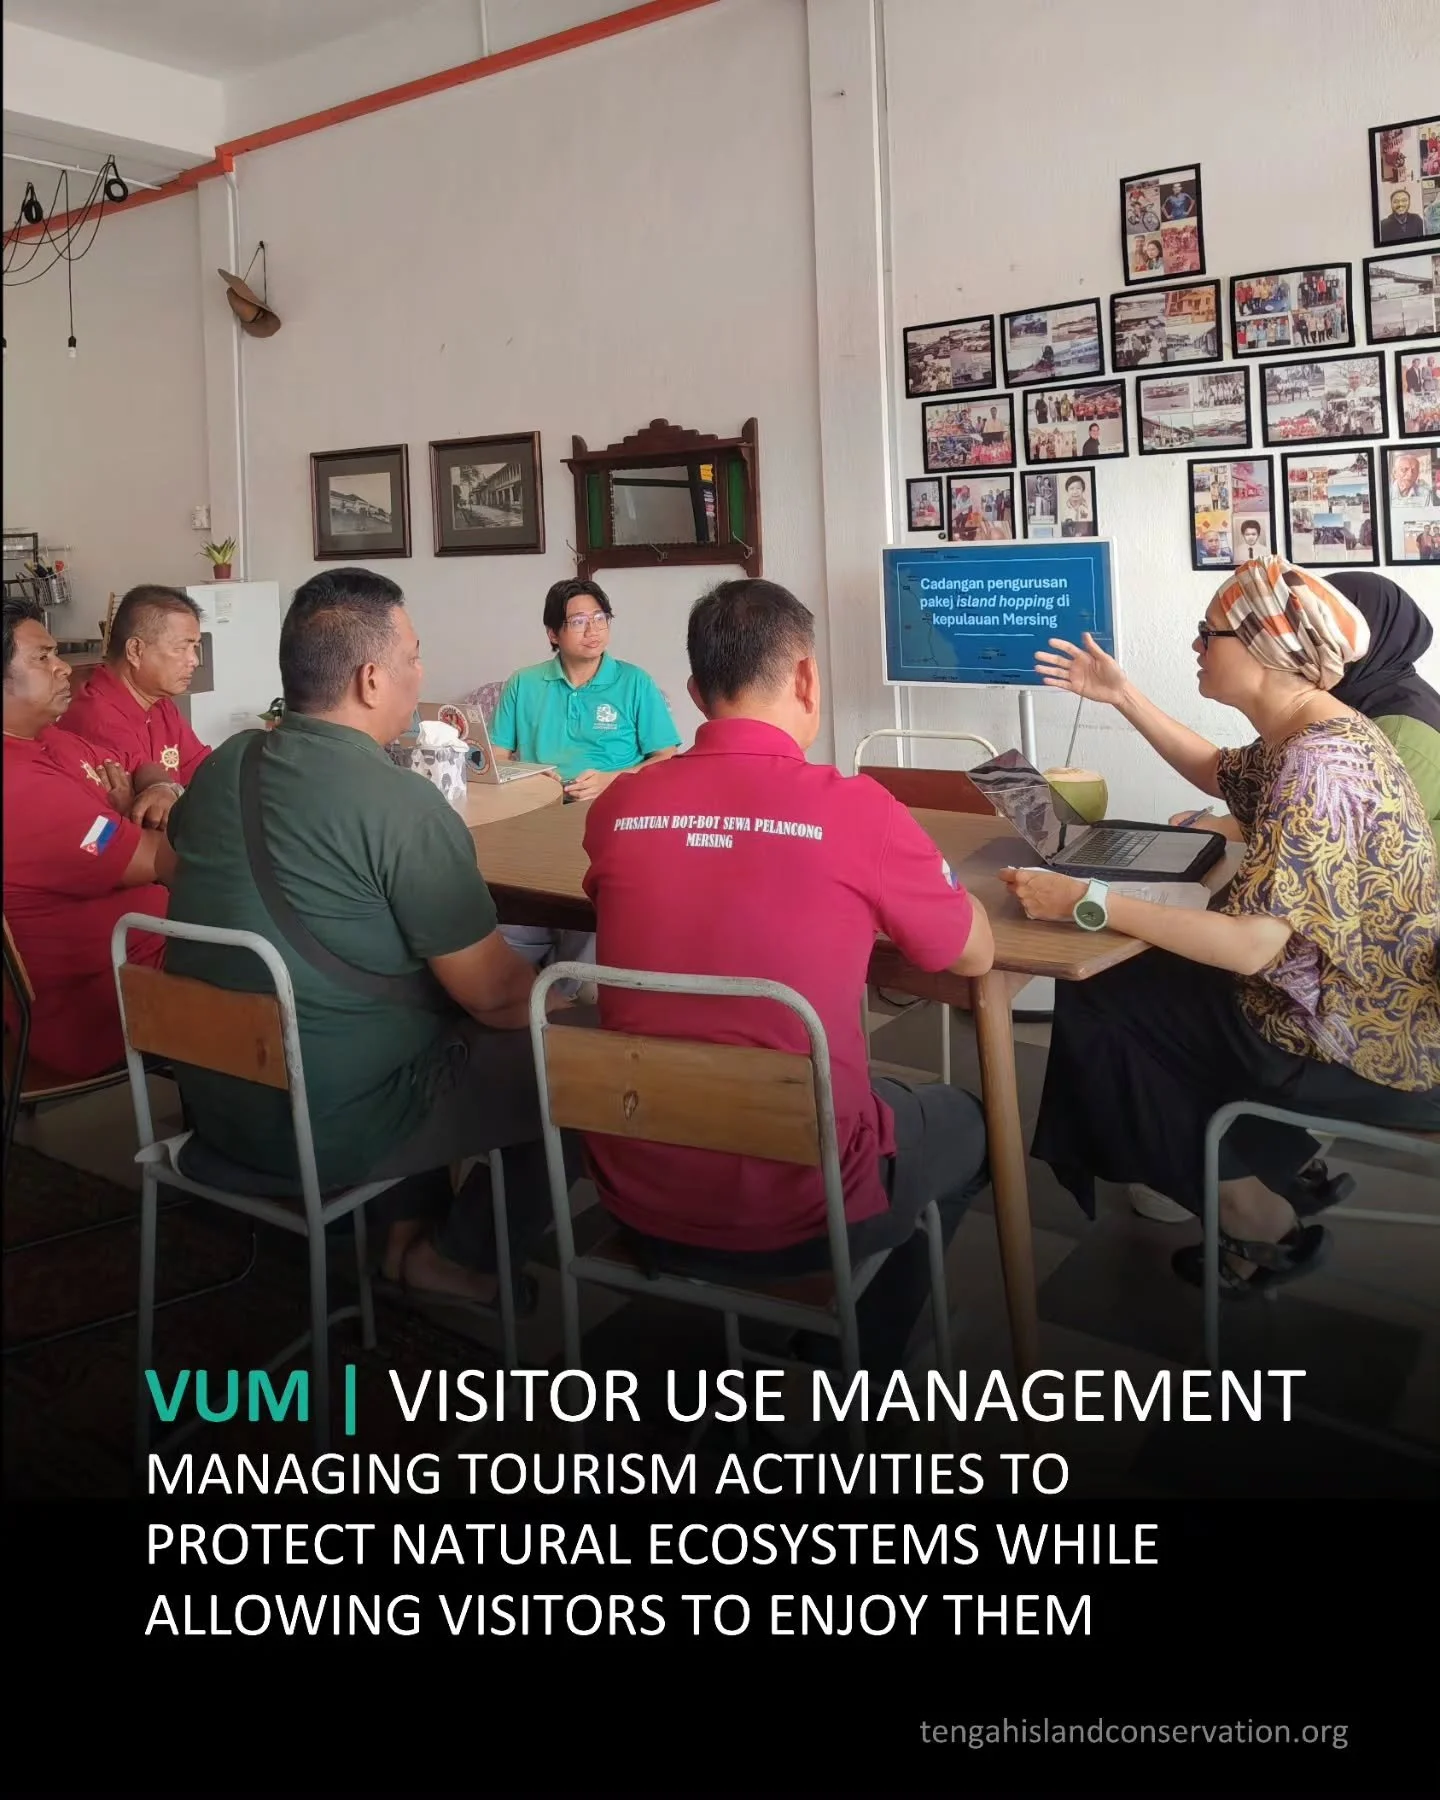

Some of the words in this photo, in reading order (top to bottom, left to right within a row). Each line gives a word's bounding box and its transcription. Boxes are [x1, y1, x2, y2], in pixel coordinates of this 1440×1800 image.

[920, 577, 984, 592] Cadangan
[987, 578, 1068, 592] pengurusan
[920, 596, 954, 610] pakej
[956, 595, 997, 608] island
[999, 594, 1054, 610] hopping
[1056, 594, 1070, 607] di
[932, 613, 999, 627] kepulauan
[1003, 612, 1058, 628] Mersing
[614, 816, 670, 831] PERSATUAN
[672, 815, 721, 830] BOT-BOT
[723, 817, 751, 832] SEWA
[754, 818, 823, 840] PELANCONG
[686, 833, 733, 849] MERSING
